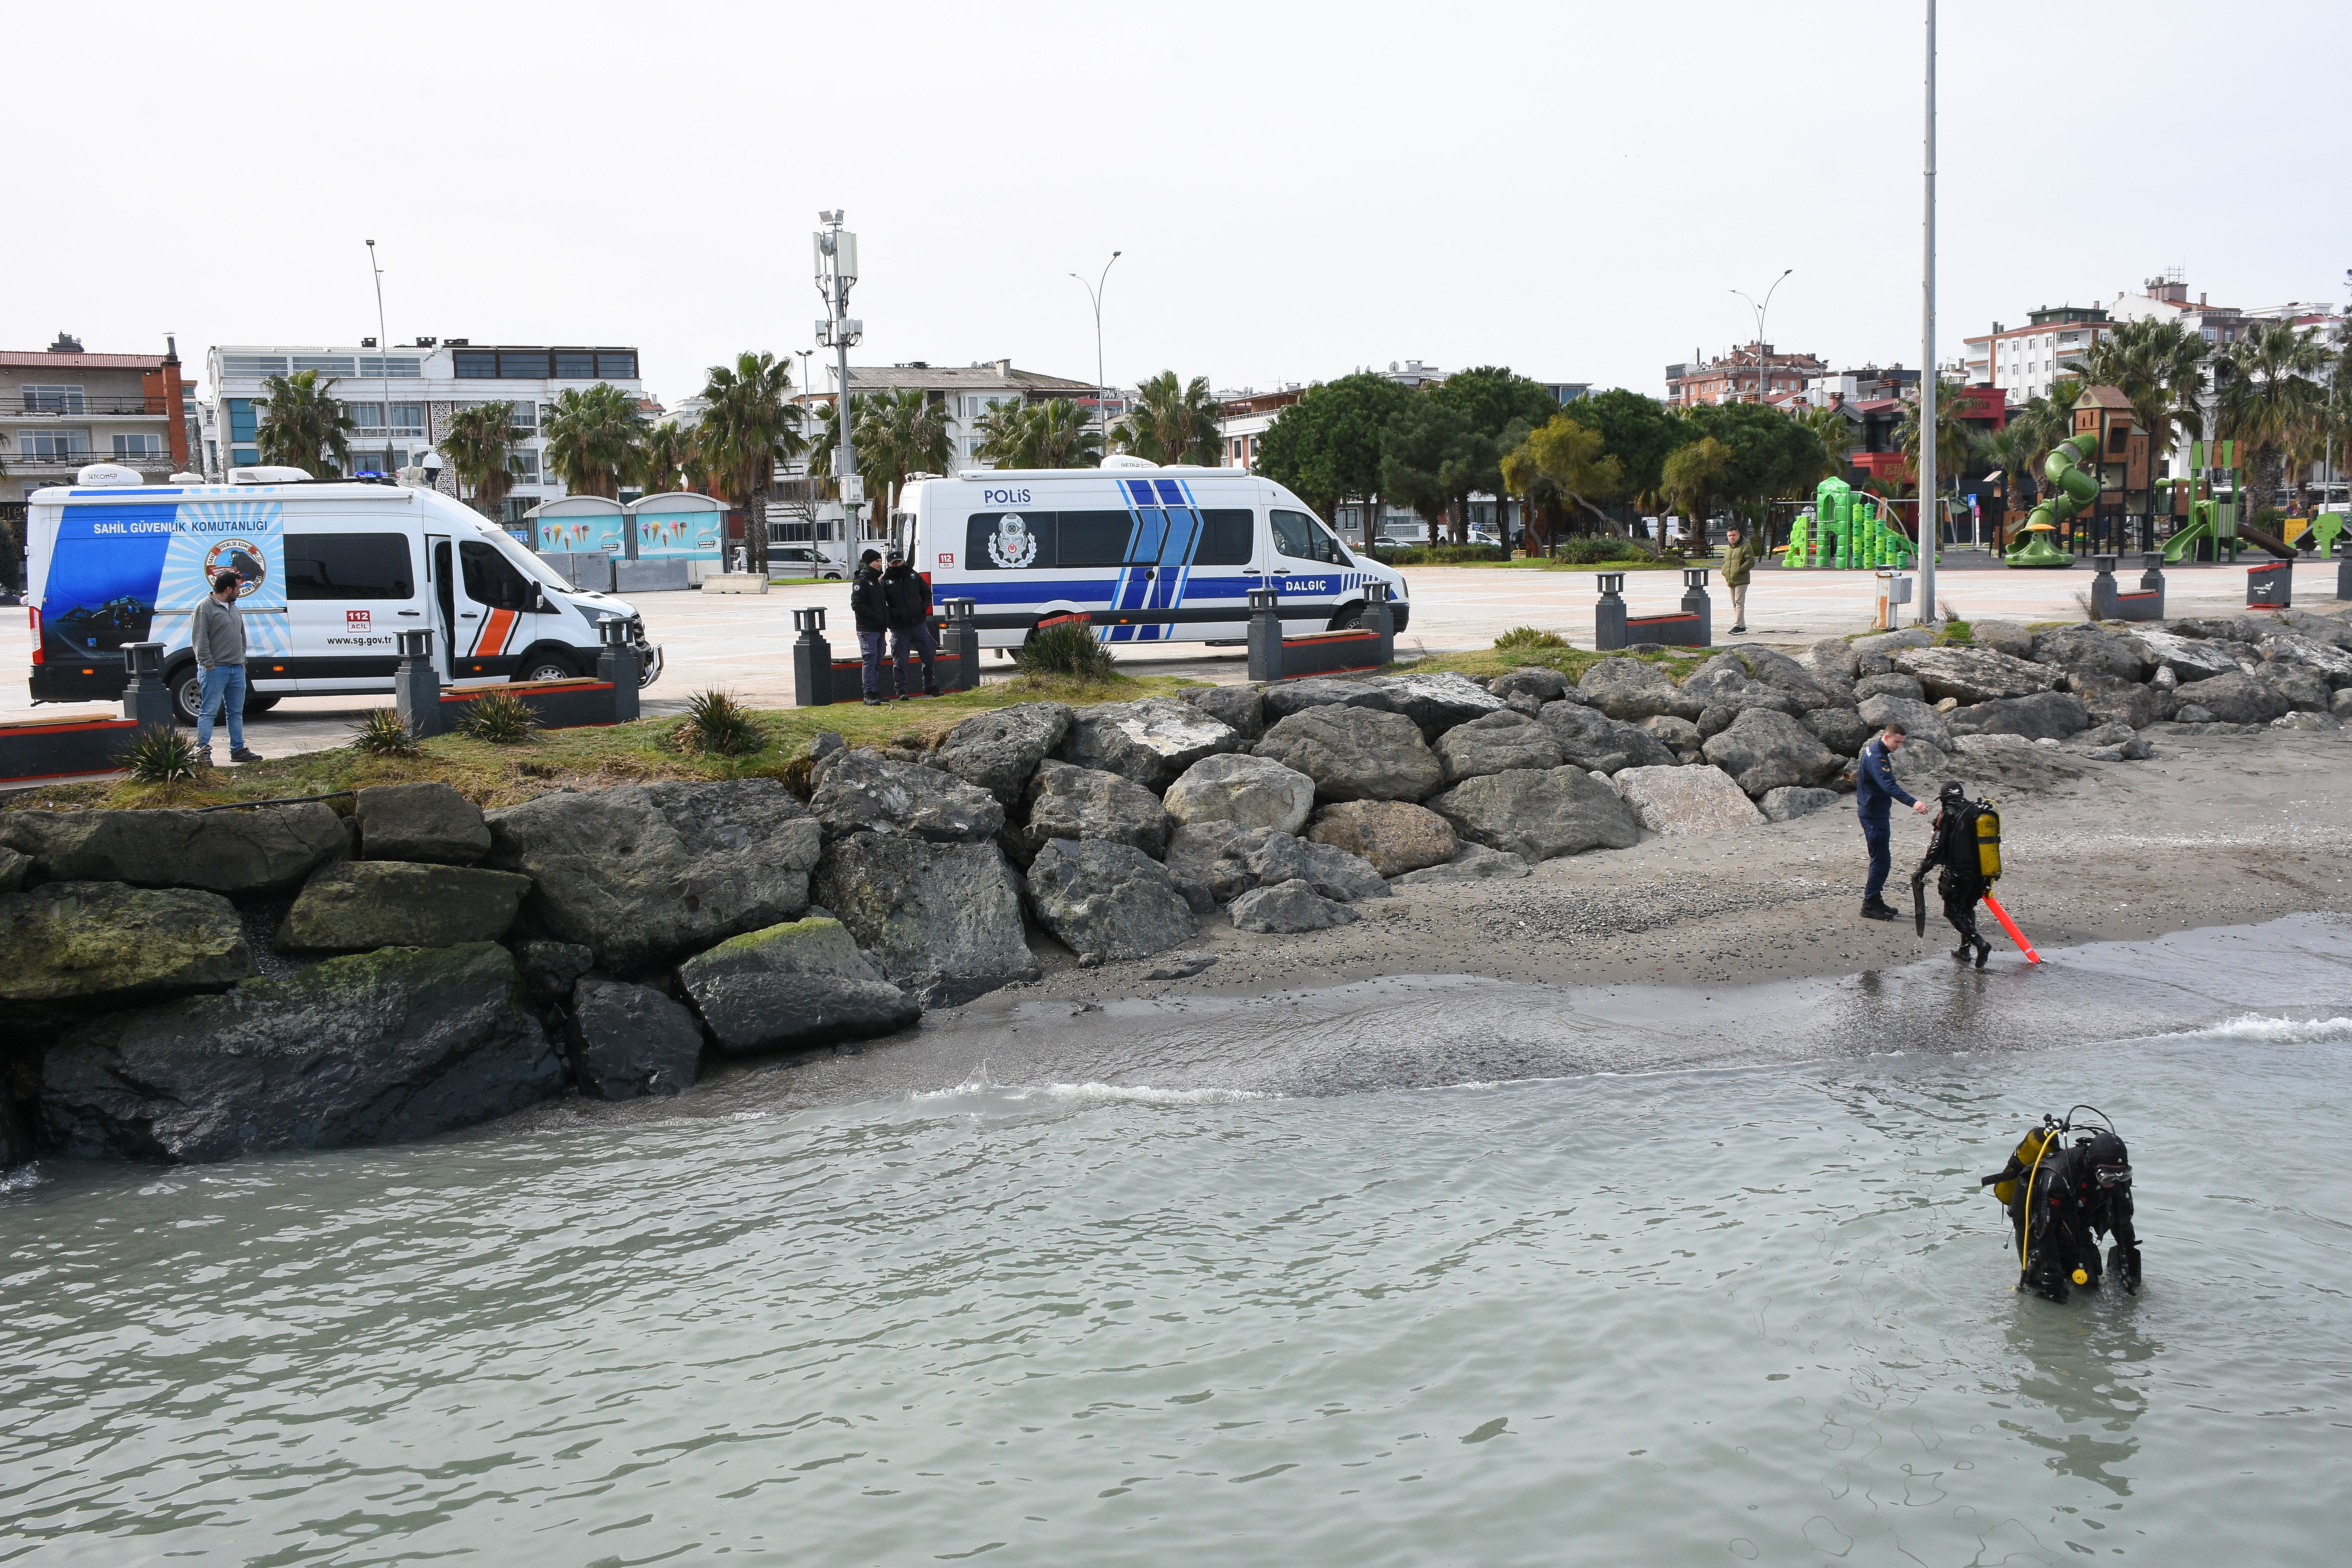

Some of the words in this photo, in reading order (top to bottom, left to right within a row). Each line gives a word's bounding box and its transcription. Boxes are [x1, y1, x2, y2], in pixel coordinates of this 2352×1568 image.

[94, 521, 127, 534] SAHİL
[130, 520, 186, 533] GÜVENLİK
[191, 518, 268, 532] KOMUTANLIĞI
[1286, 581, 1326, 591] DALGIÇ
[327, 636, 392, 646] www.sg.gov.tr
